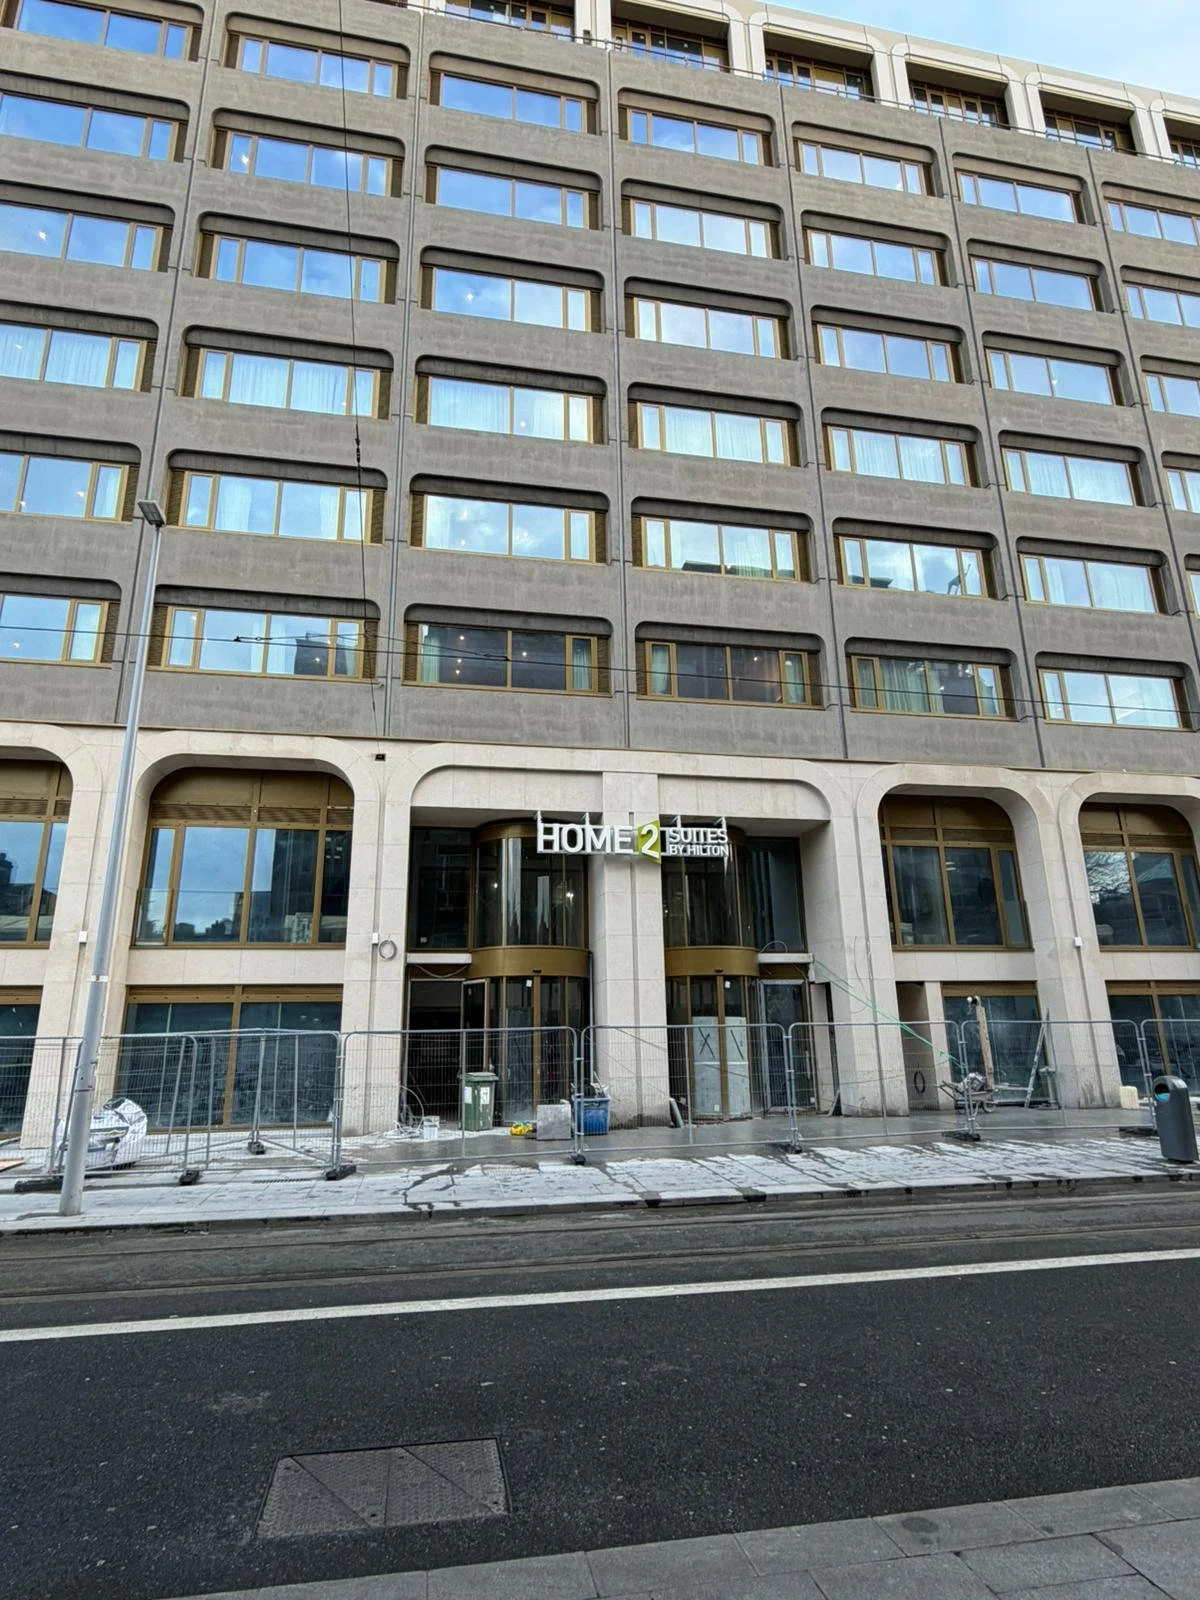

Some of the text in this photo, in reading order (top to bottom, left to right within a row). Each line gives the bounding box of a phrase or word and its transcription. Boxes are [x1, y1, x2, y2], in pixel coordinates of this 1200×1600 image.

[537, 823, 660, 859] HOME 2
[669, 828, 728, 844] SUITES
[669, 844, 729, 857] BY HILTON
